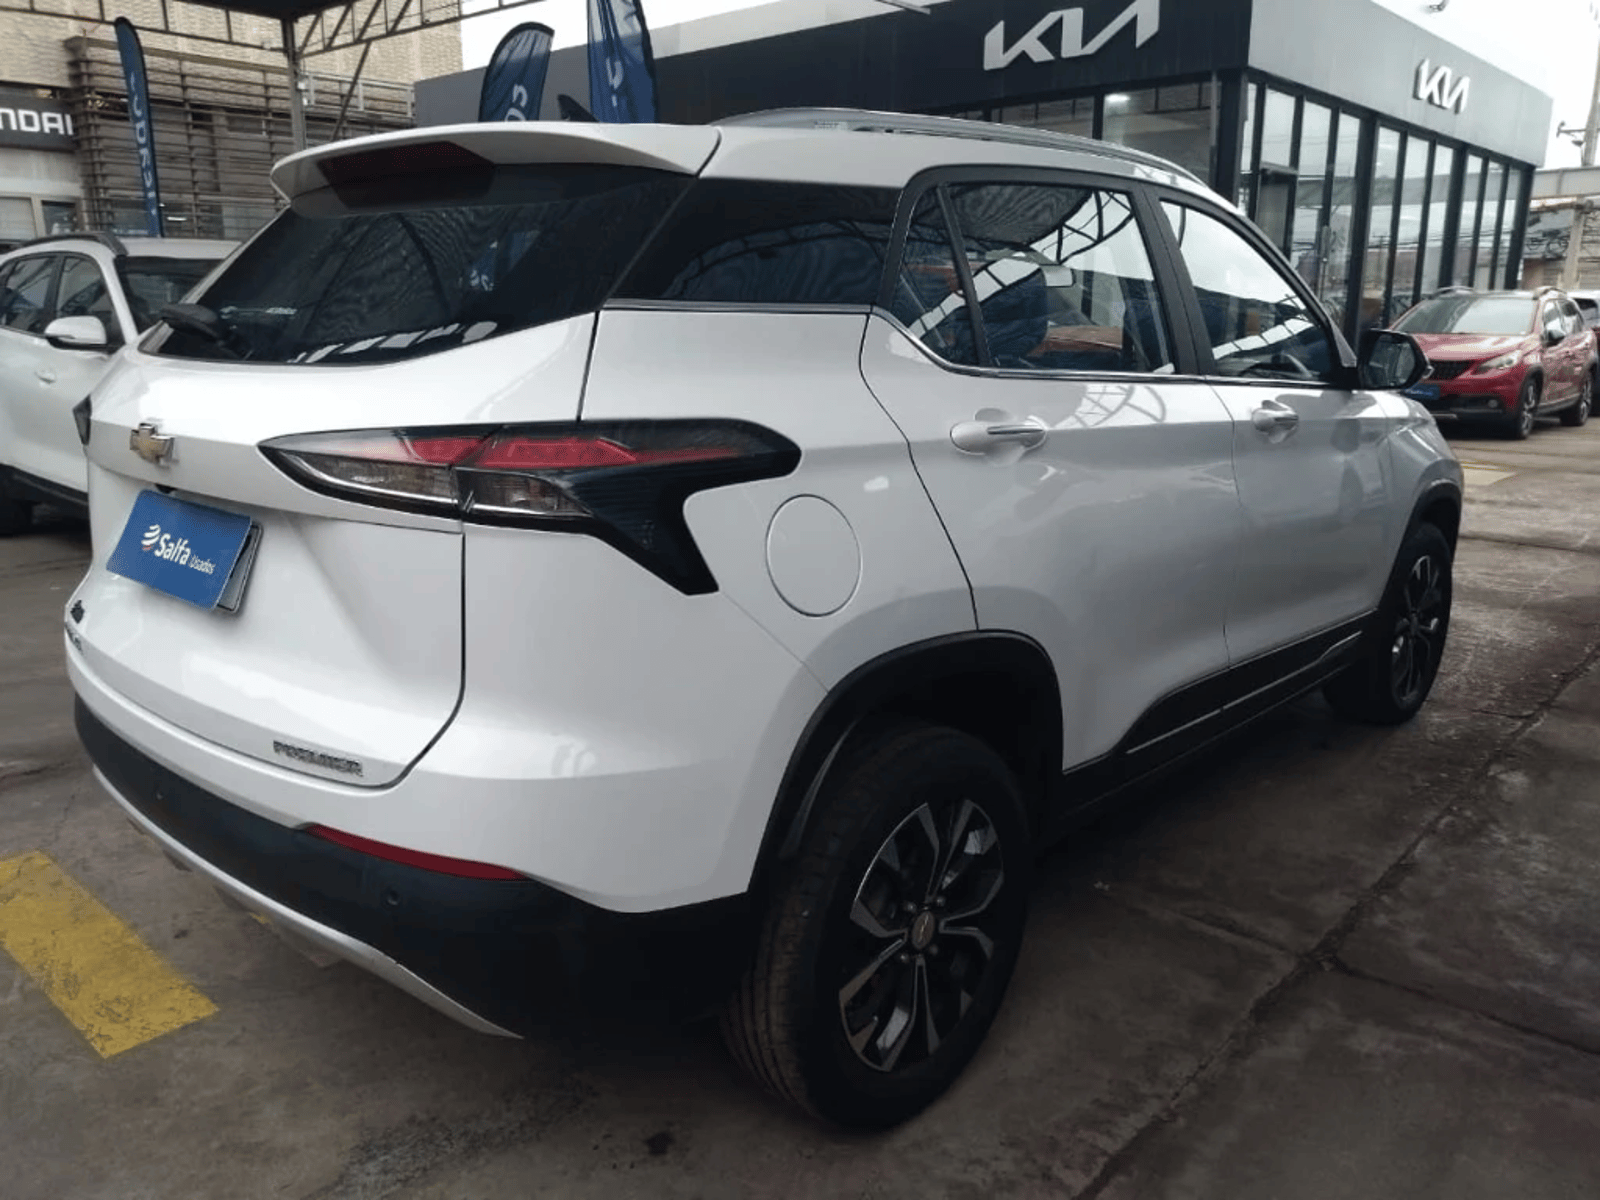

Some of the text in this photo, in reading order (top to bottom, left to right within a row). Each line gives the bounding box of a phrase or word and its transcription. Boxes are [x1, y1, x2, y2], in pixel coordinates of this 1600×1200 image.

[983, 0, 1160, 71] KIA
[1417, 58, 1470, 113] KIA
[154, 533, 191, 566] Salfa
